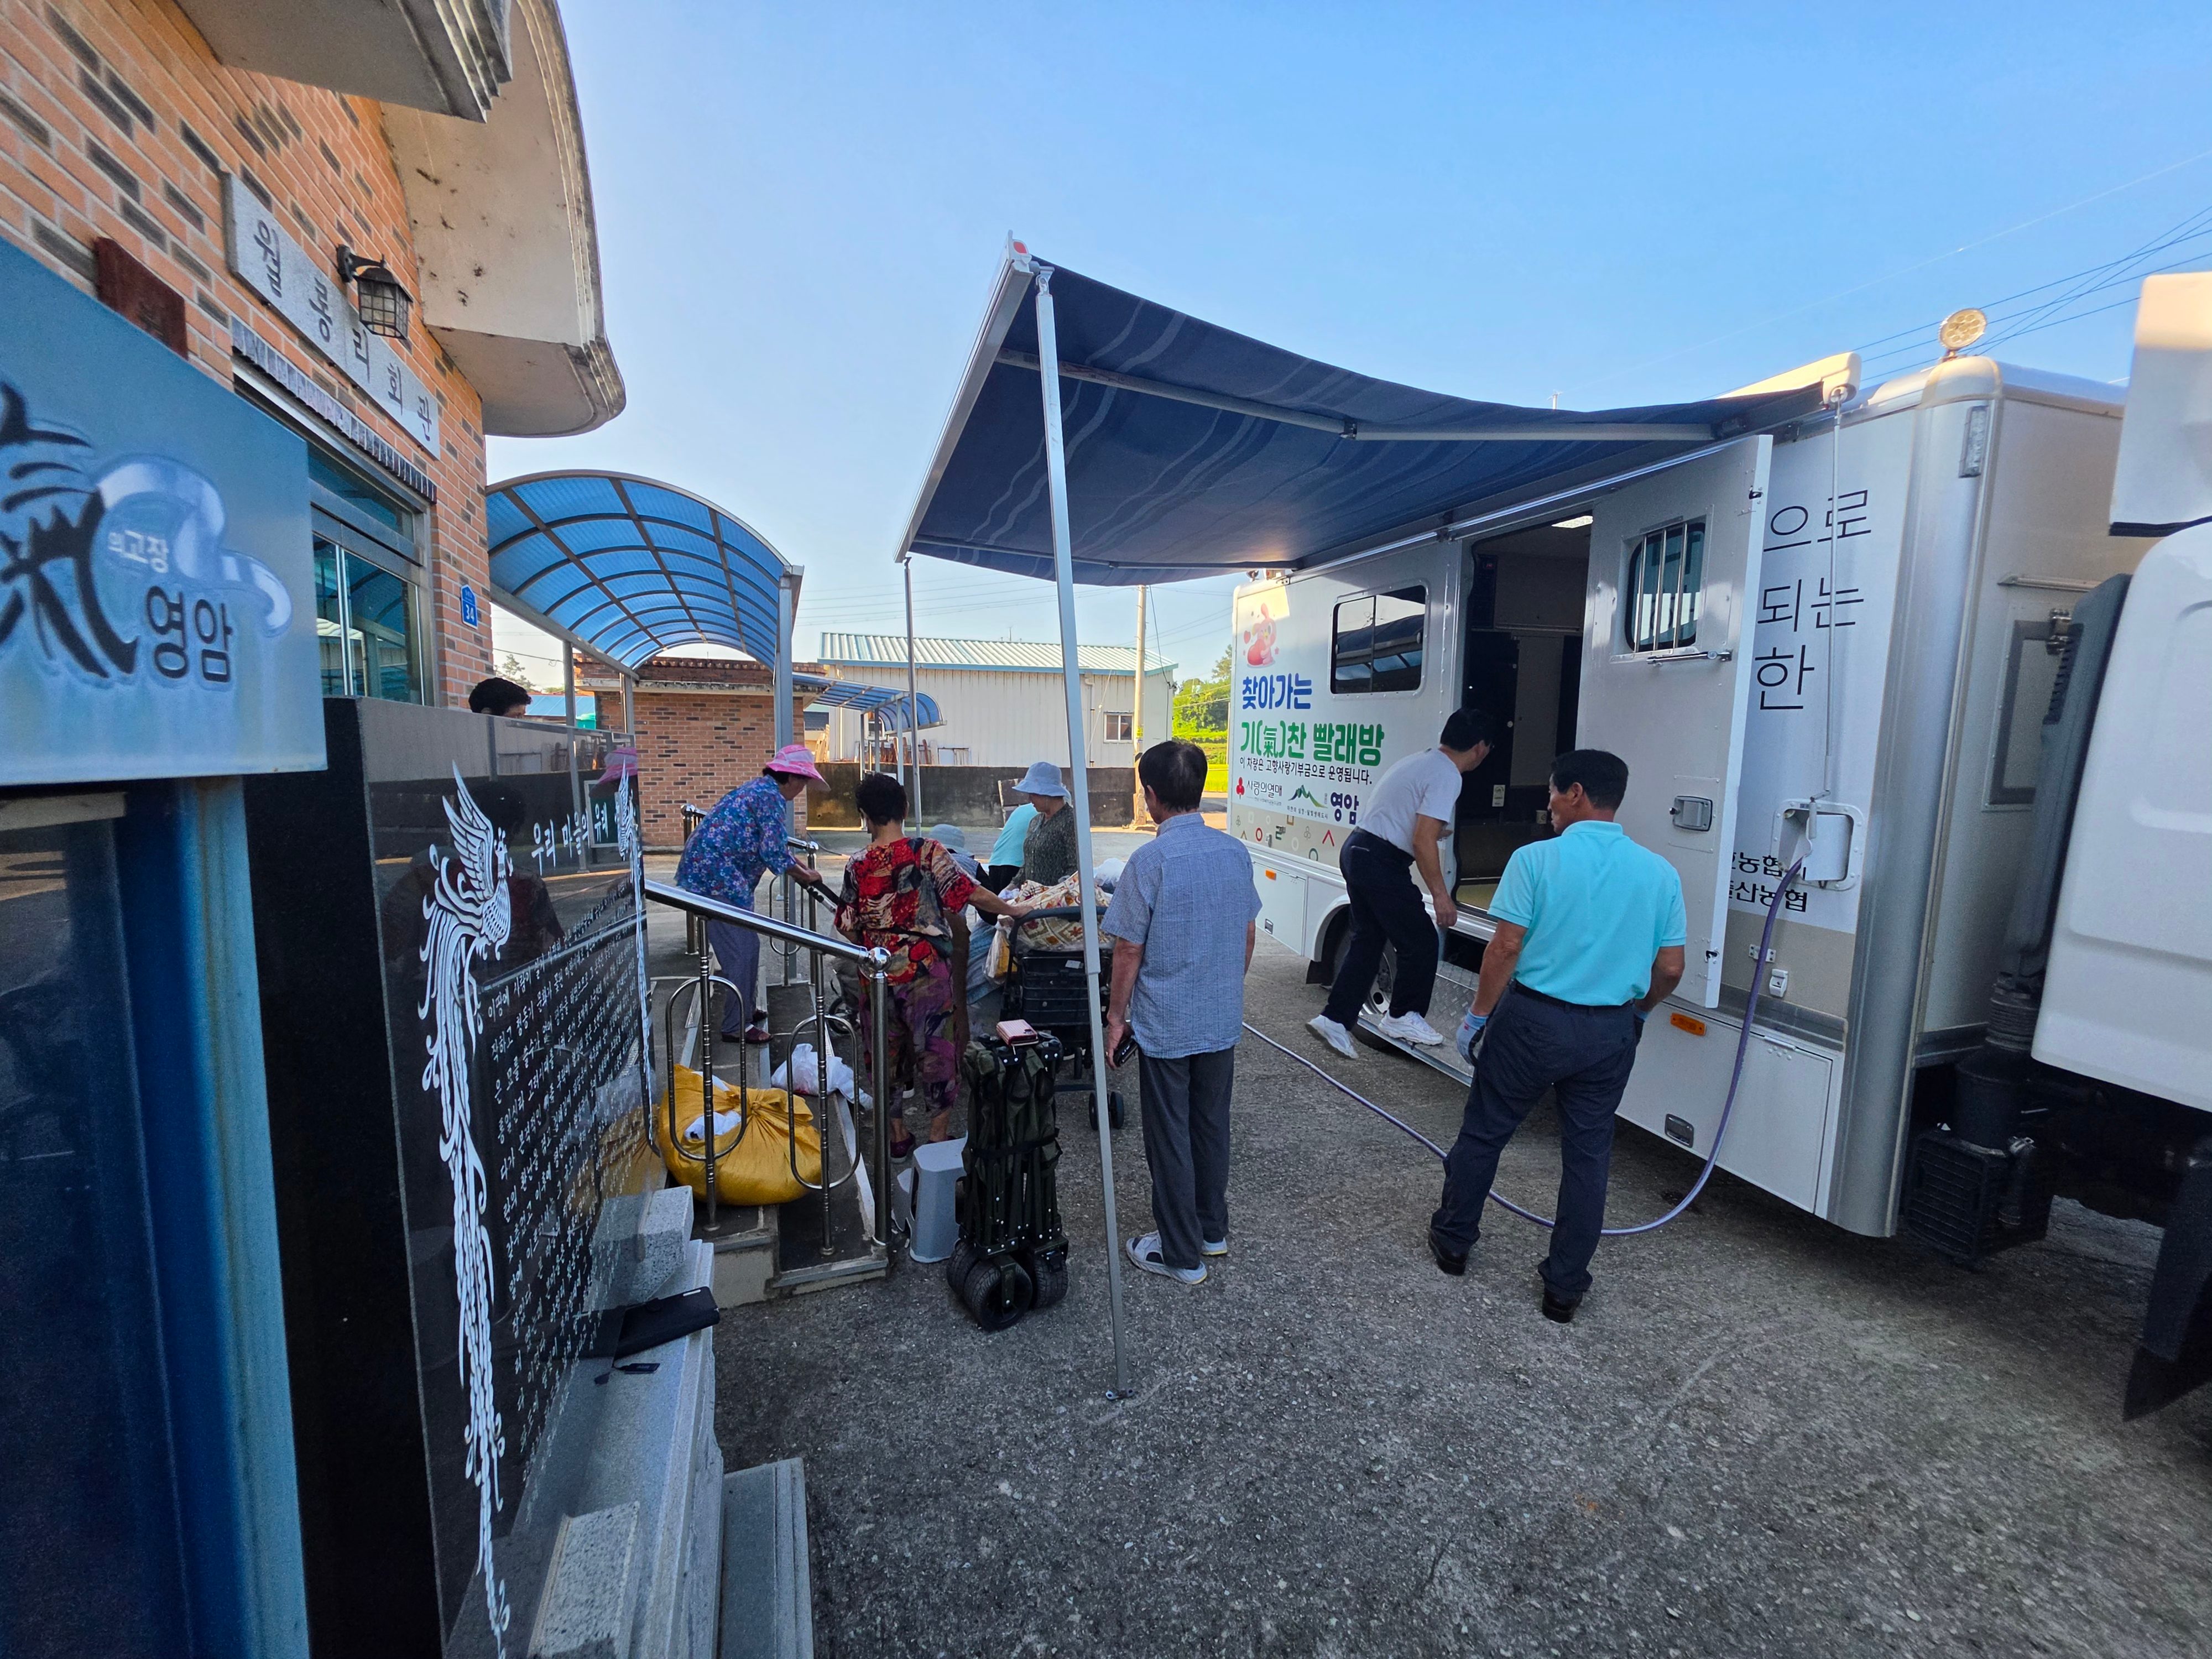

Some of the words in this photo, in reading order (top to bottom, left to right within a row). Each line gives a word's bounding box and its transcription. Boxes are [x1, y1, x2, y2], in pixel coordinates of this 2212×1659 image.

[1764, 489, 1872, 552] 으로
[466, 603, 474, 623] 34
[1756, 577, 1865, 632] 되는
[145, 586, 232, 684] 영암
[1242, 673, 1312, 710] 찾아가는
[1754, 644, 1815, 711] 한
[1240, 720, 1307, 759] 기(氣)찬
[1313, 723, 1385, 766] 빨래방
[1240, 757, 1245, 769] 이
[1246, 758, 1264, 771] 차량은
[1266, 760, 1326, 778] 고향사랑기부금으로
[1328, 765, 1373, 785] 운영됩니다.
[1246, 780, 1282, 798] 사랑의열매
[1330, 792, 1359, 825] 영암
[531, 819, 556, 877] 우리
[488, 985, 509, 1020] 이땅에
[491, 1026, 513, 1061] 작하고
[517, 1000, 534, 1036] 청동기
[494, 1079, 502, 1104] 은
[498, 1091, 524, 1144] 통일신라
[500, 1147, 514, 1179] 다가
[535, 1162, 551, 1199] 이후에
[503, 1185, 517, 1222] 란의
